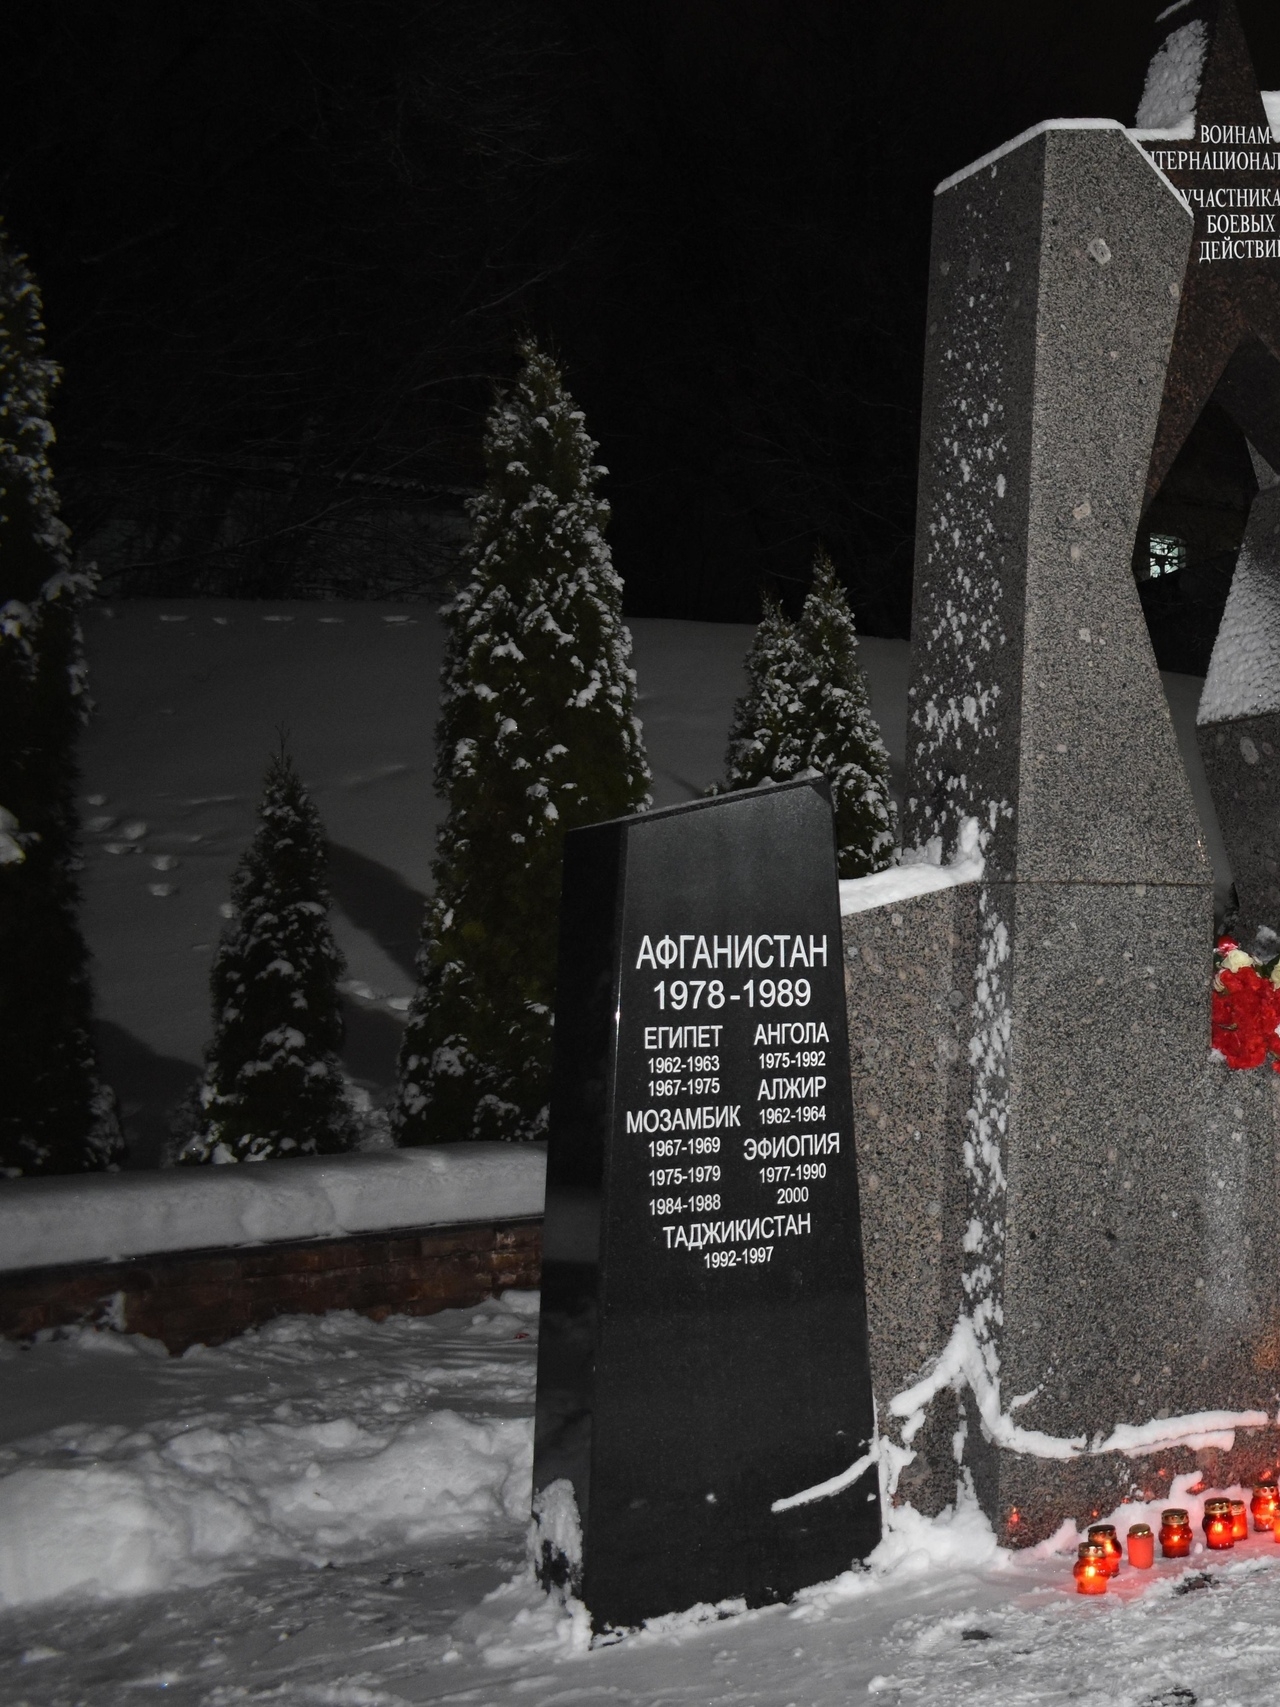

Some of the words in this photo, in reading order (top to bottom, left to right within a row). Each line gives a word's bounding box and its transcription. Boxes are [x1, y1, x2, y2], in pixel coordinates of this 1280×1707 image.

[1201, 125, 1273, 145] ВОИНАМ-
[1207, 214, 1275, 234] БОЕВЫХ
[636, 935, 827, 969] АФГАНИСТАН
[654, 979, 811, 1010] 1978-1989
[644, 1025, 723, 1049] ЕГИПЕТ
[754, 1022, 829, 1045] АНГОЛА
[648, 1055, 720, 1074] 1962-1963
[759, 1051, 826, 1069] 1975-1992
[648, 1078, 720, 1096] 1967-1975
[758, 1077, 826, 1101] АЛЖИР
[627, 1105, 741, 1133] МОЗАМБИК
[759, 1106, 826, 1125] 1962-1964
[649, 1137, 721, 1157] 1967-1969
[743, 1133, 840, 1160] ЭФИОПИЯ
[649, 1166, 721, 1186] 1975-1979
[759, 1163, 826, 1183] 1977-1990
[649, 1194, 721, 1215] 1984-1988
[777, 1187, 809, 1204] 2000
[663, 1213, 811, 1250] ТАДЖИКИСТАН
[704, 1246, 774, 1268] 1992-1997
